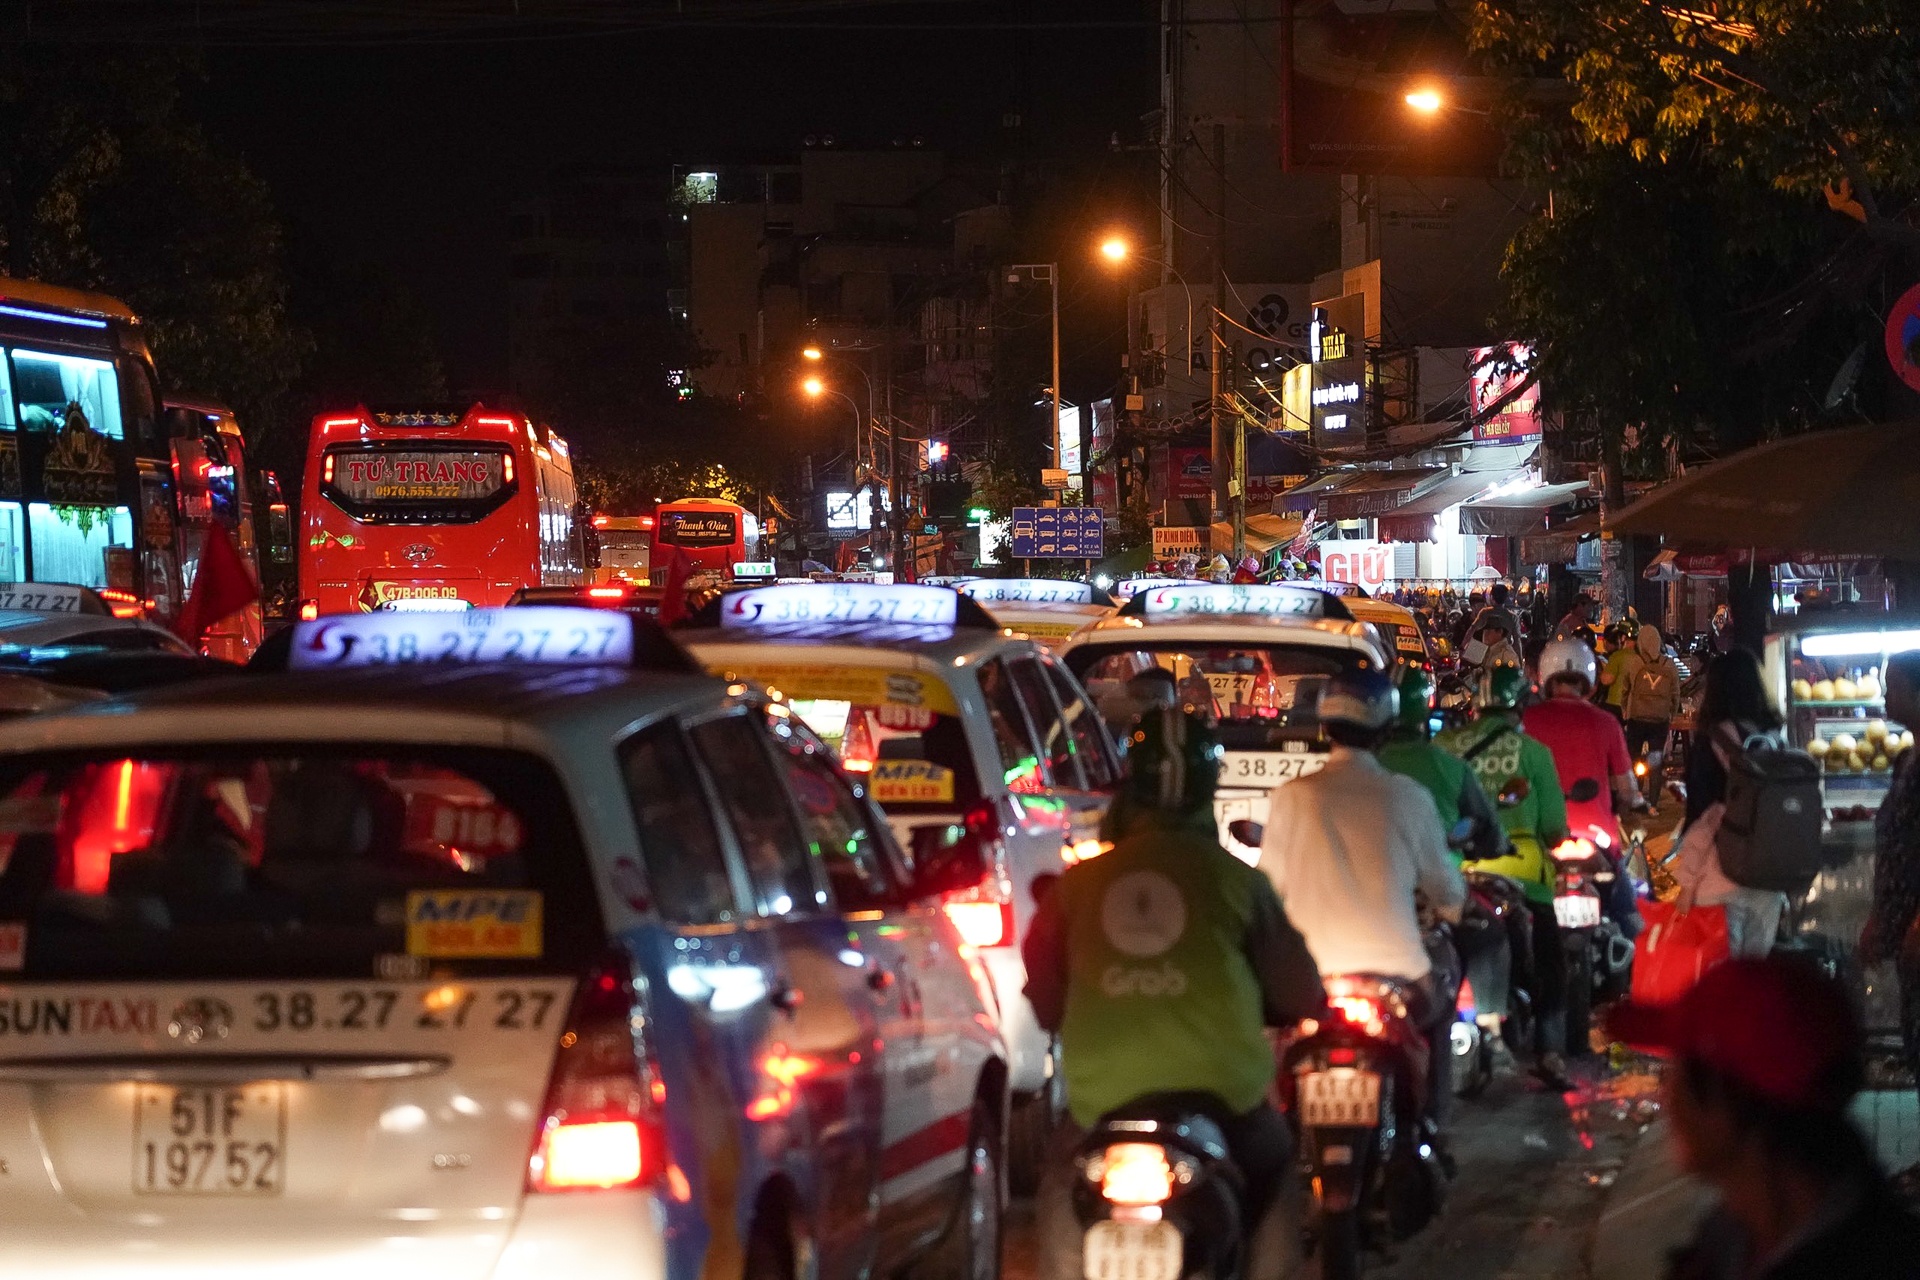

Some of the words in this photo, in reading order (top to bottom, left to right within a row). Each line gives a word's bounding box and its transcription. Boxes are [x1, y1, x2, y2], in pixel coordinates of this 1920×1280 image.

[349, 456, 386, 483] TƯ
[395, 461, 489, 484] TRANG
[375, 485, 460, 497] 0976.555.777
[675, 520, 704, 530] Thanh
[1325, 546, 1390, 585] GIỮ
[387, 586, 458, 600] 47B-006.09
[984, 589, 1032, 602] 38.27
[1038, 590, 1058, 602] 27
[1065, 590, 1086, 603] 27
[1343, 587, 1356, 597] 27
[21, 593, 47, 609] 27
[51, 595, 78, 612] 27
[776, 599, 857, 623] 38.27
[866, 599, 903, 623] 27
[911, 599, 946, 621] 27
[1188, 596, 1251, 614] 38.27
[1258, 596, 1285, 613] 27
[1292, 597, 1323, 614] 27
[367, 630, 489, 665] 38.27
[502, 629, 553, 661] 27
[568, 627, 616, 658] 27
[1213, 677, 1229, 689] 27
[1233, 677, 1249, 690] 27
[1237, 758, 1305, 778] 38.27
[1471, 750, 1520, 776] ood
[254, 990, 399, 1032] 38.27
[494, 990, 556, 1031] 27
